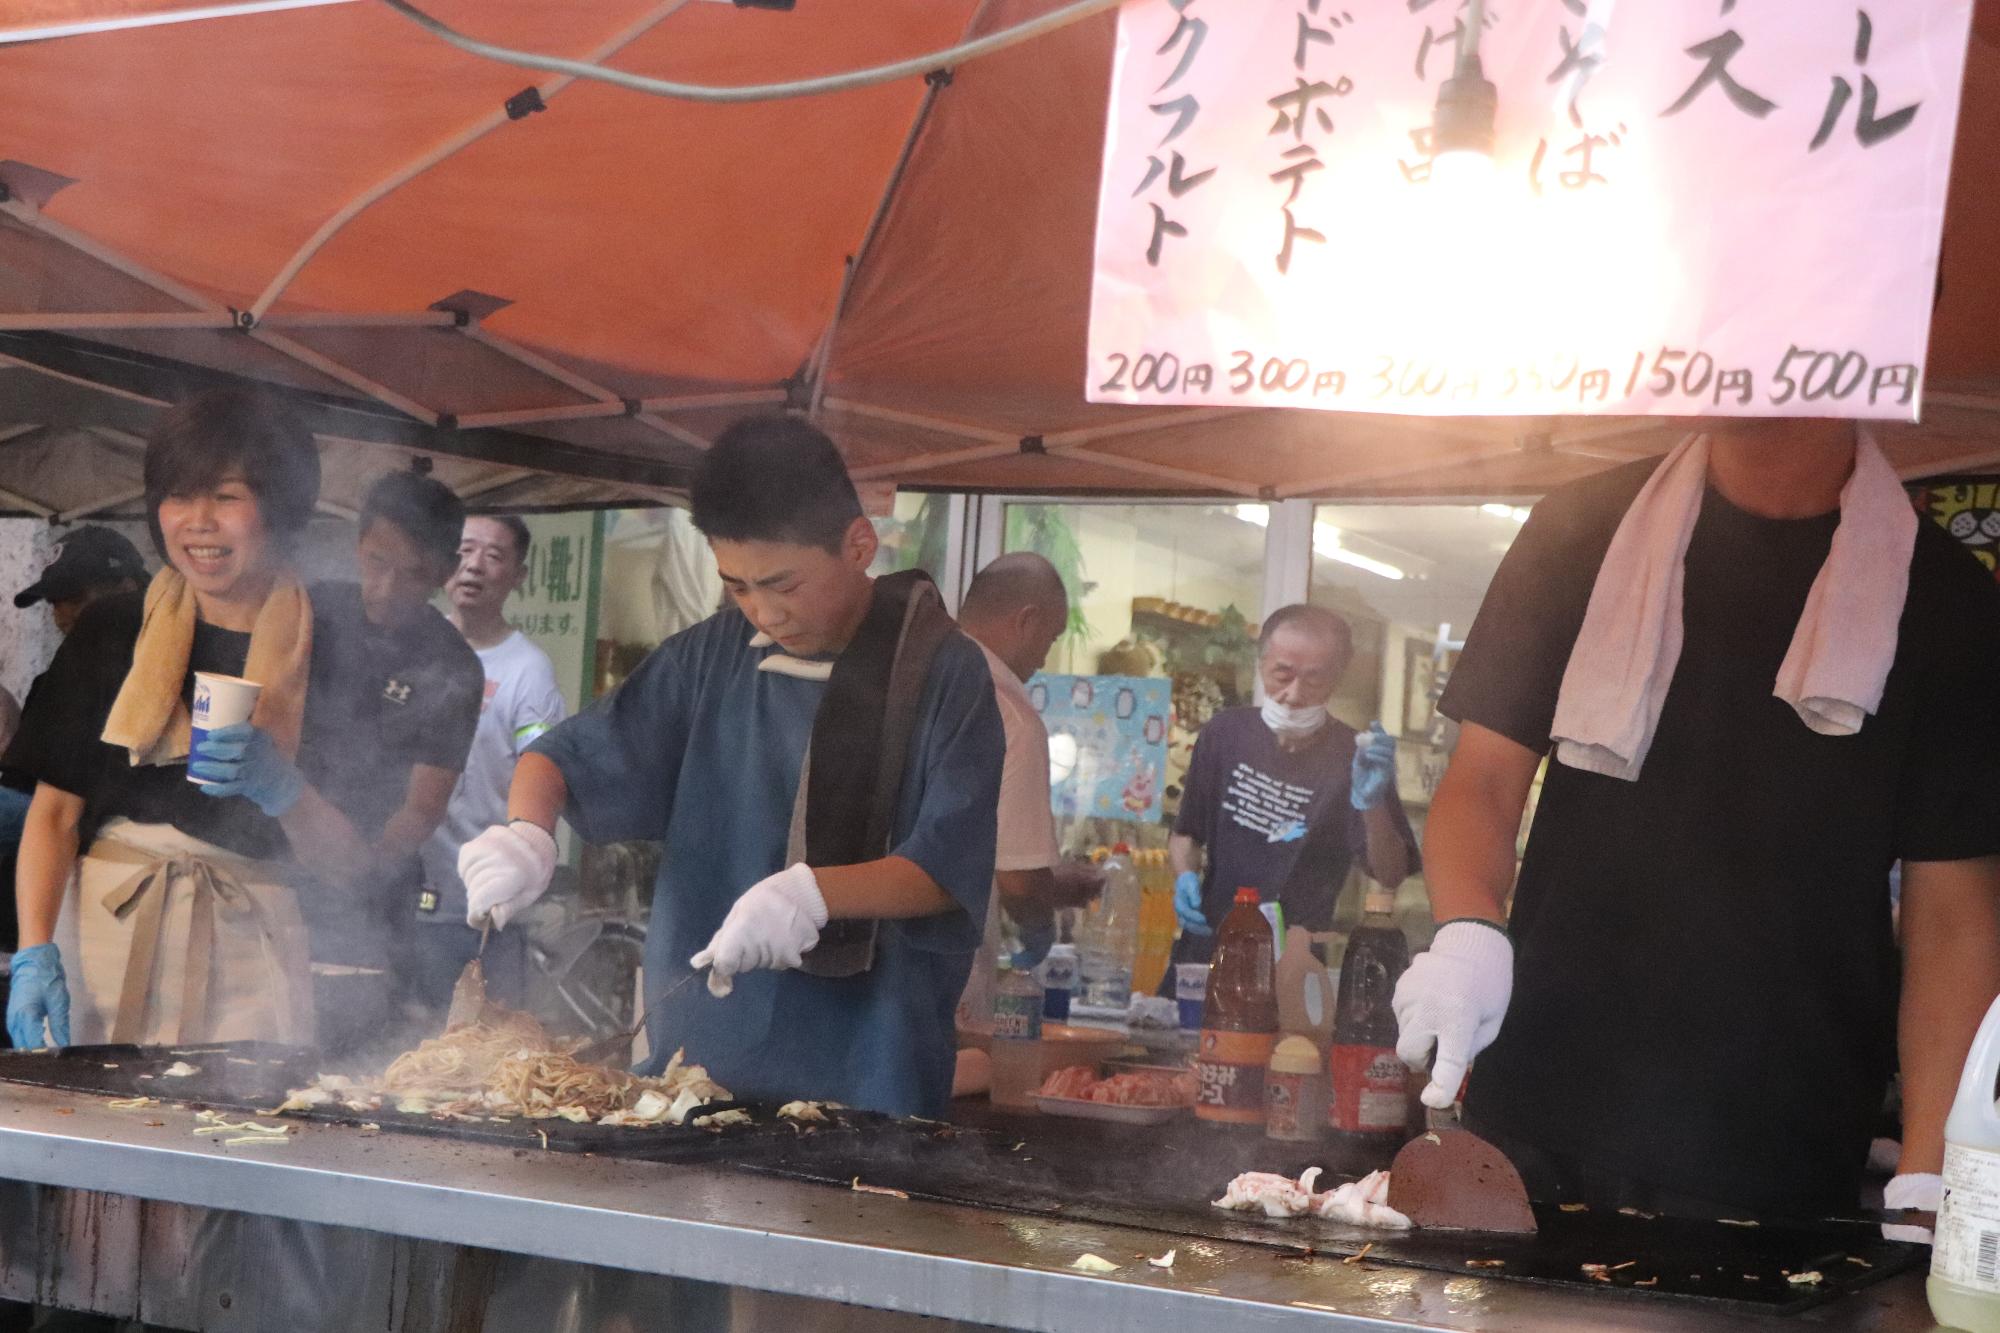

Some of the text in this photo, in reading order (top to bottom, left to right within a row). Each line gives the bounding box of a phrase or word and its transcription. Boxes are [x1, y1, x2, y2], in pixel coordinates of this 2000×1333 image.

[1131, 0, 1218, 267] クフルト
[1267, 0, 1354, 275] ドポテト
[1529, 0, 1628, 195] そば
[1099, 351, 1213, 395] 200円
[1229, 350, 1346, 397] 300円
[1624, 346, 1753, 405] 150円
[1769, 345, 1918, 405] 500円
